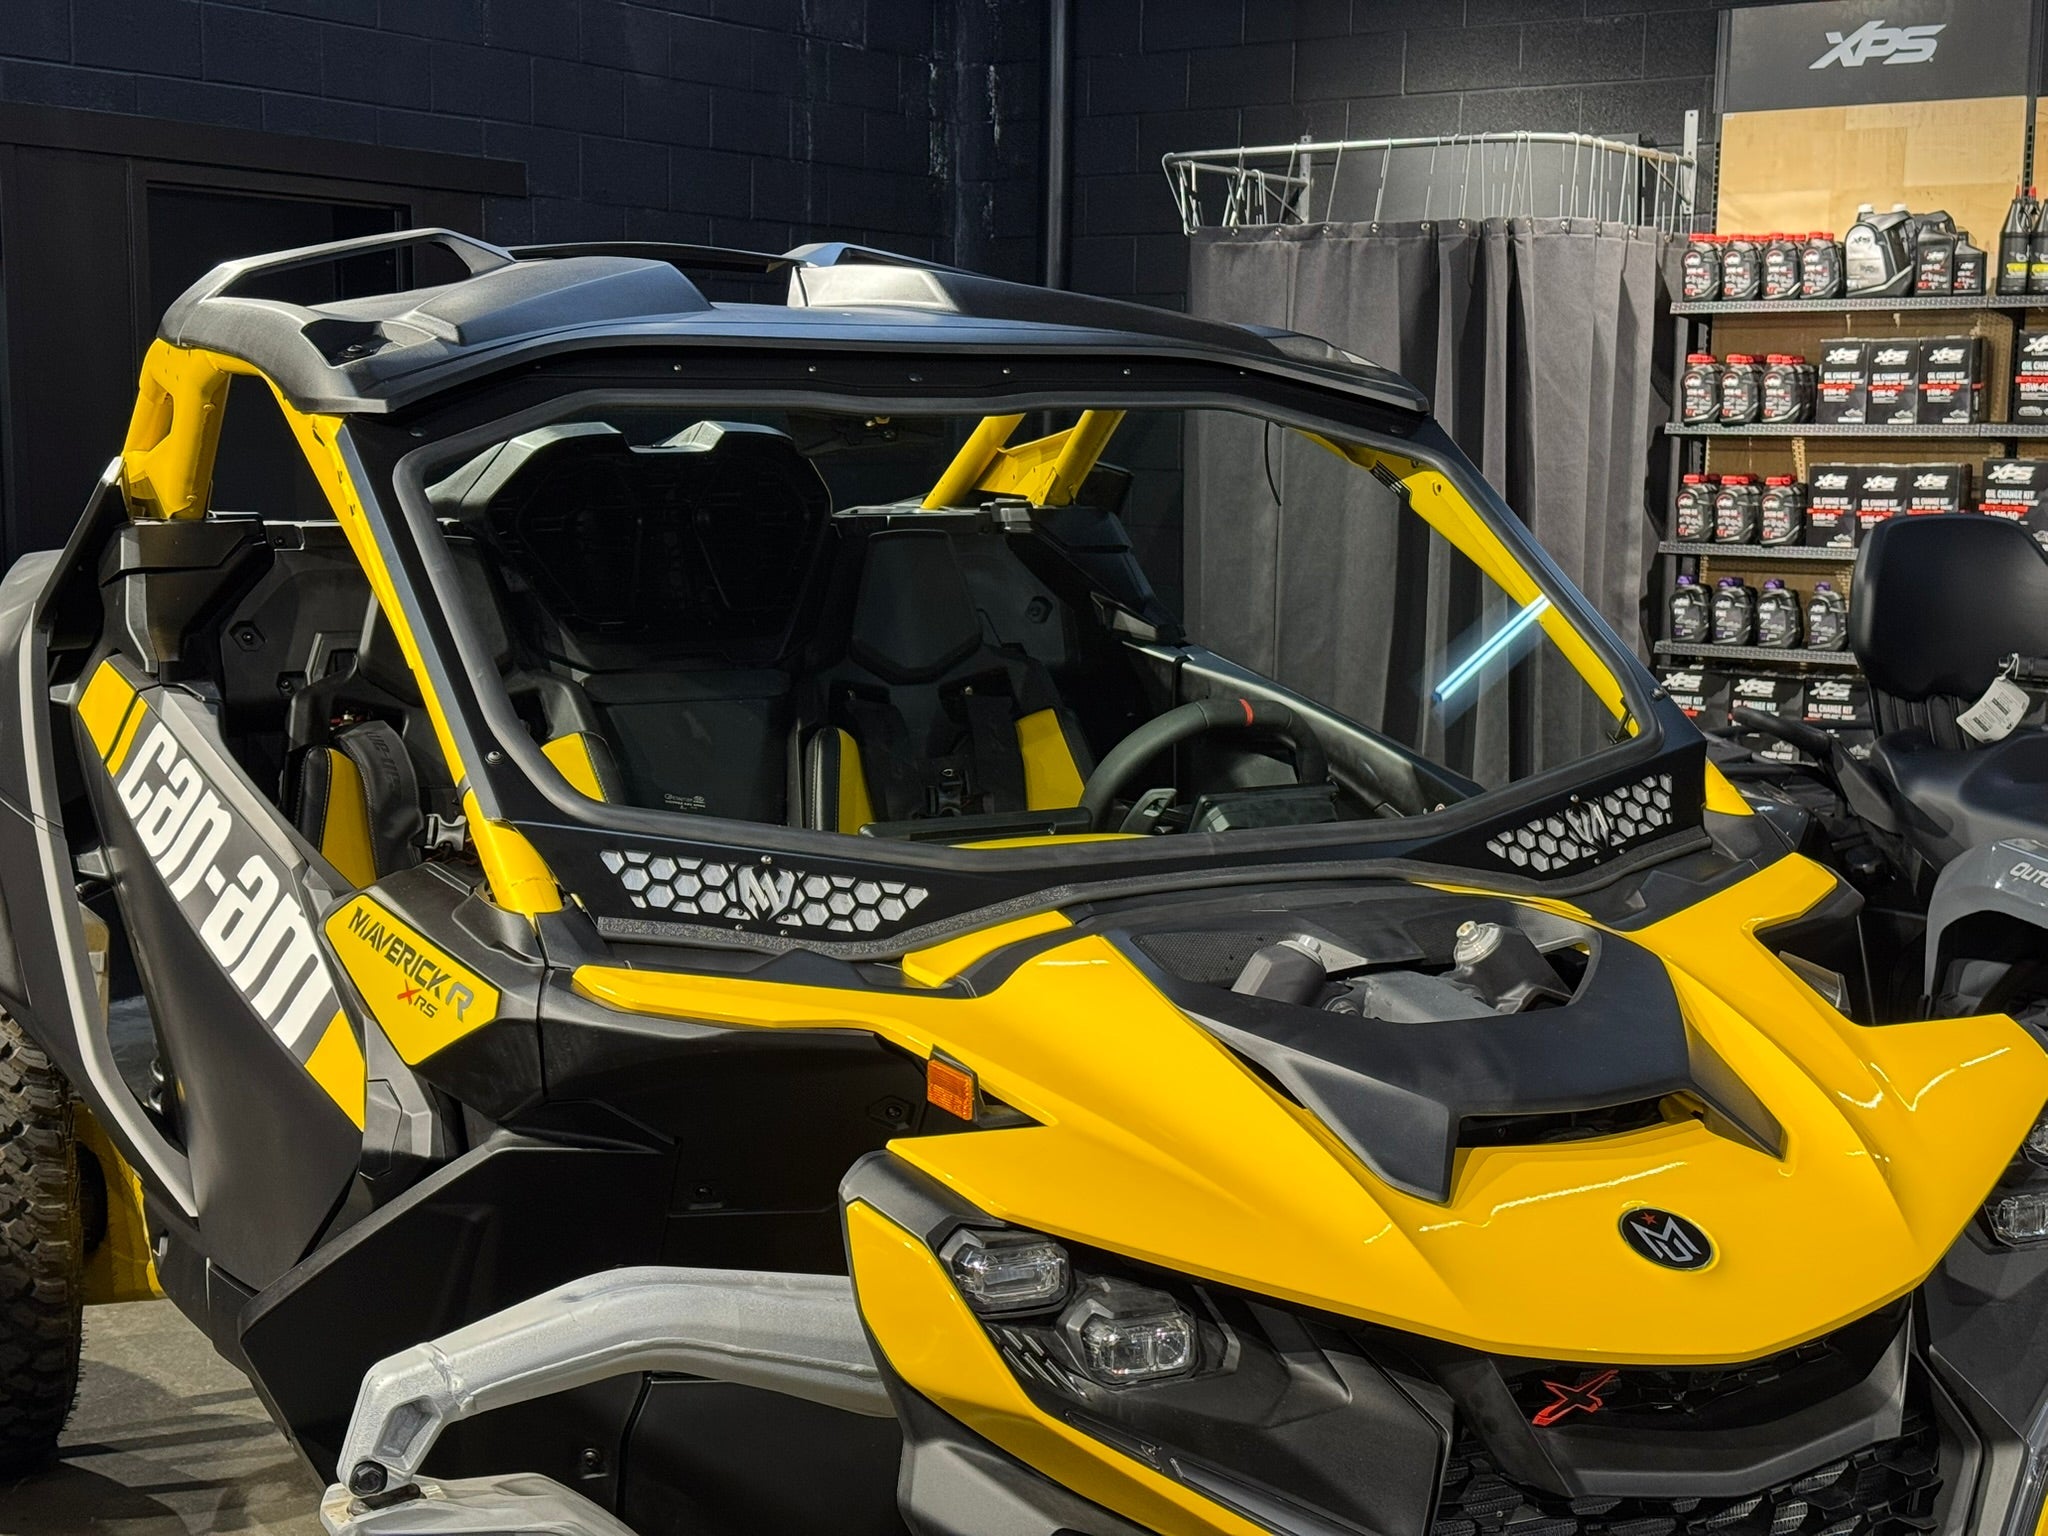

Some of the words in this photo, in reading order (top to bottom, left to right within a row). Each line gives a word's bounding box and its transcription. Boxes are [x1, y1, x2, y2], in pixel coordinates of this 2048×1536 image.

[1809, 20, 1947, 70] XPS
[1826, 348, 1860, 362] XPS
[1874, 349, 1909, 363] XPS
[1928, 347, 1966, 362] XPS
[1987, 463, 2036, 480] XPS
[1815, 473, 1849, 487] XPS
[1863, 475, 1898, 489] XPS
[1913, 473, 1949, 487] XPS
[1985, 489, 1996, 498] OIL
[1997, 490, 2022, 499] CHANGE
[2023, 491, 2036, 500] KIT
[1661, 672, 1703, 689] XPS
[1734, 678, 1776, 693] XPS
[1809, 681, 1852, 697] XPS
[1693, 696, 1703, 706] KIT
[1767, 702, 1777, 711] KIT
[1808, 703, 1817, 712] OIL
[1818, 704, 1842, 714] CHANGE
[1843, 705, 1853, 715] KIT
[117, 721, 333, 1050] can-am
[348, 906, 450, 1000] MAVERICK
[445, 981, 474, 1023] R
